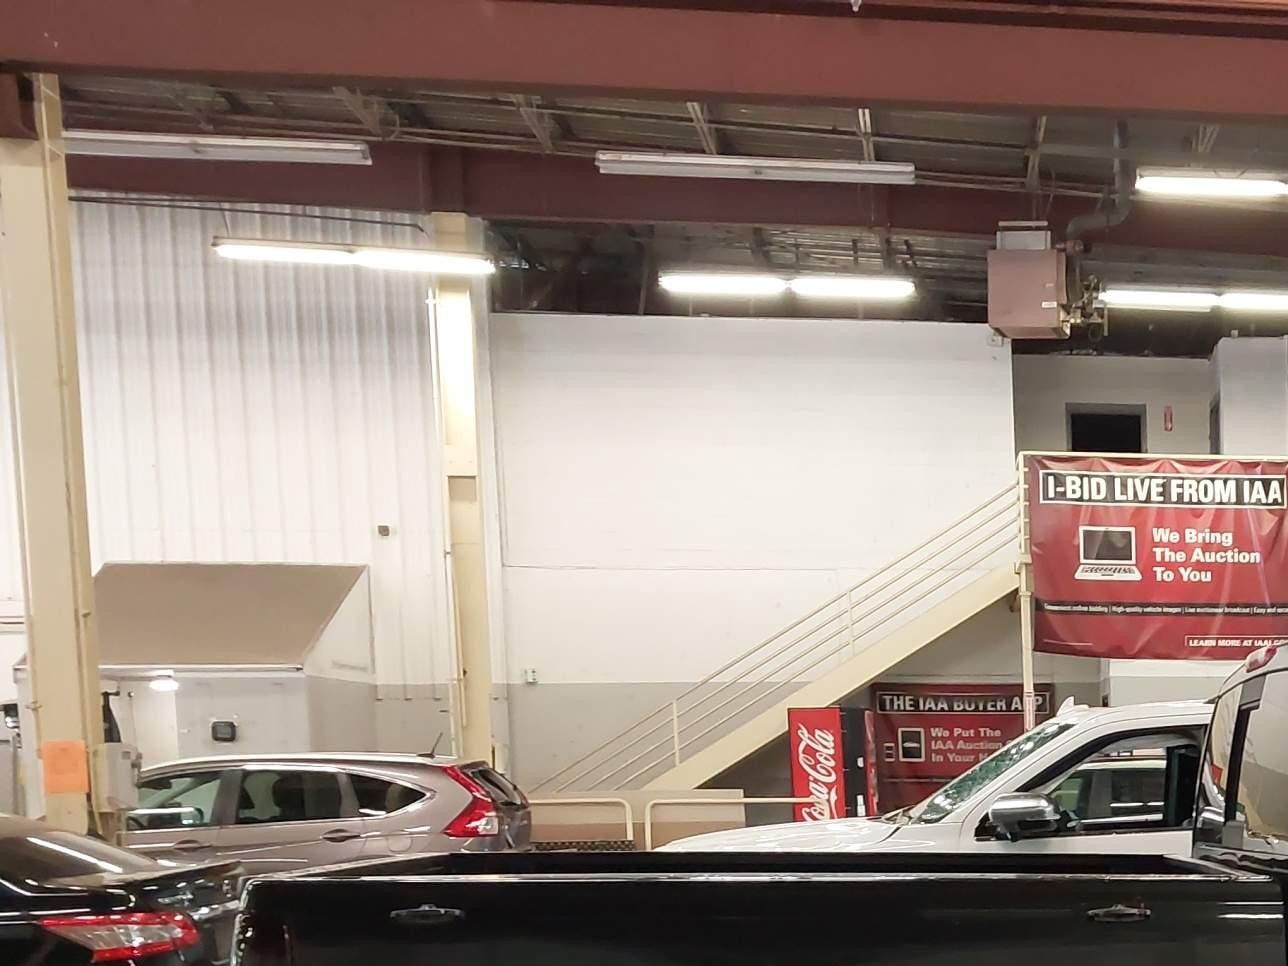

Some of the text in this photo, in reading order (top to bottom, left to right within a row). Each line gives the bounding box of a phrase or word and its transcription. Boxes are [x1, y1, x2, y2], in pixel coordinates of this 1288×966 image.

[1047, 475, 1282, 504] I-BID LIVE FROM IAA
[1152, 528, 1233, 547] We Bring
[1152, 547, 1260, 564] The Auction
[1152, 567, 1212, 583] To You
[1188, 638, 1216, 647] LEARN
[1217, 638, 1241, 647] MORE
[1242, 638, 1253, 647] AT
[883, 695, 1043, 711] THE IAA BUYER AP
[930, 727, 1002, 738] We Put The
[931, 740, 954, 751] IAA
[956, 740, 1003, 751] Auction
[931, 752, 944, 763] In
[946, 752, 976, 763] Your
